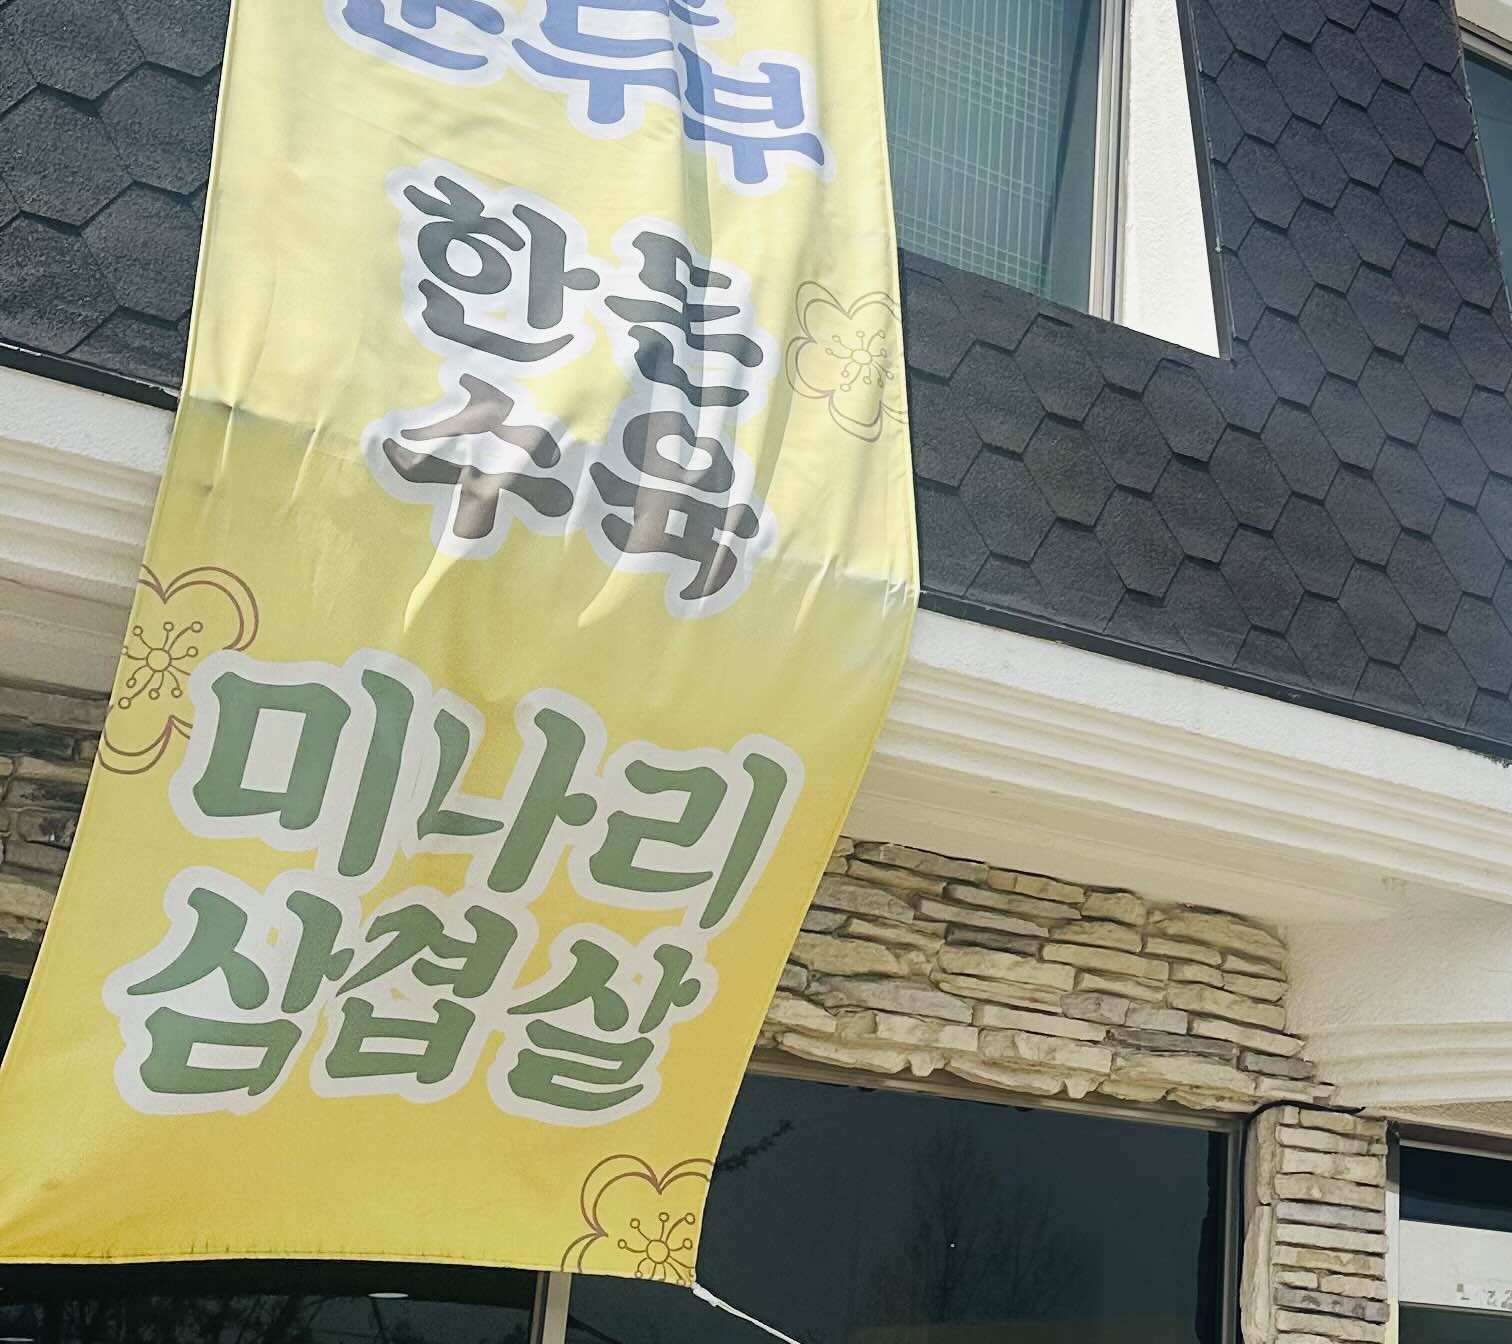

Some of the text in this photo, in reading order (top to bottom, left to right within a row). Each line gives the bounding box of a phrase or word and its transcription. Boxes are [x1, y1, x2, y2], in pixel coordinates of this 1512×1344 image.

[403, 175, 764, 409] 한돈
[380, 372, 761, 601] 수육
[192, 669, 788, 930] 미나리
[126, 886, 702, 1113] 삼겹살
